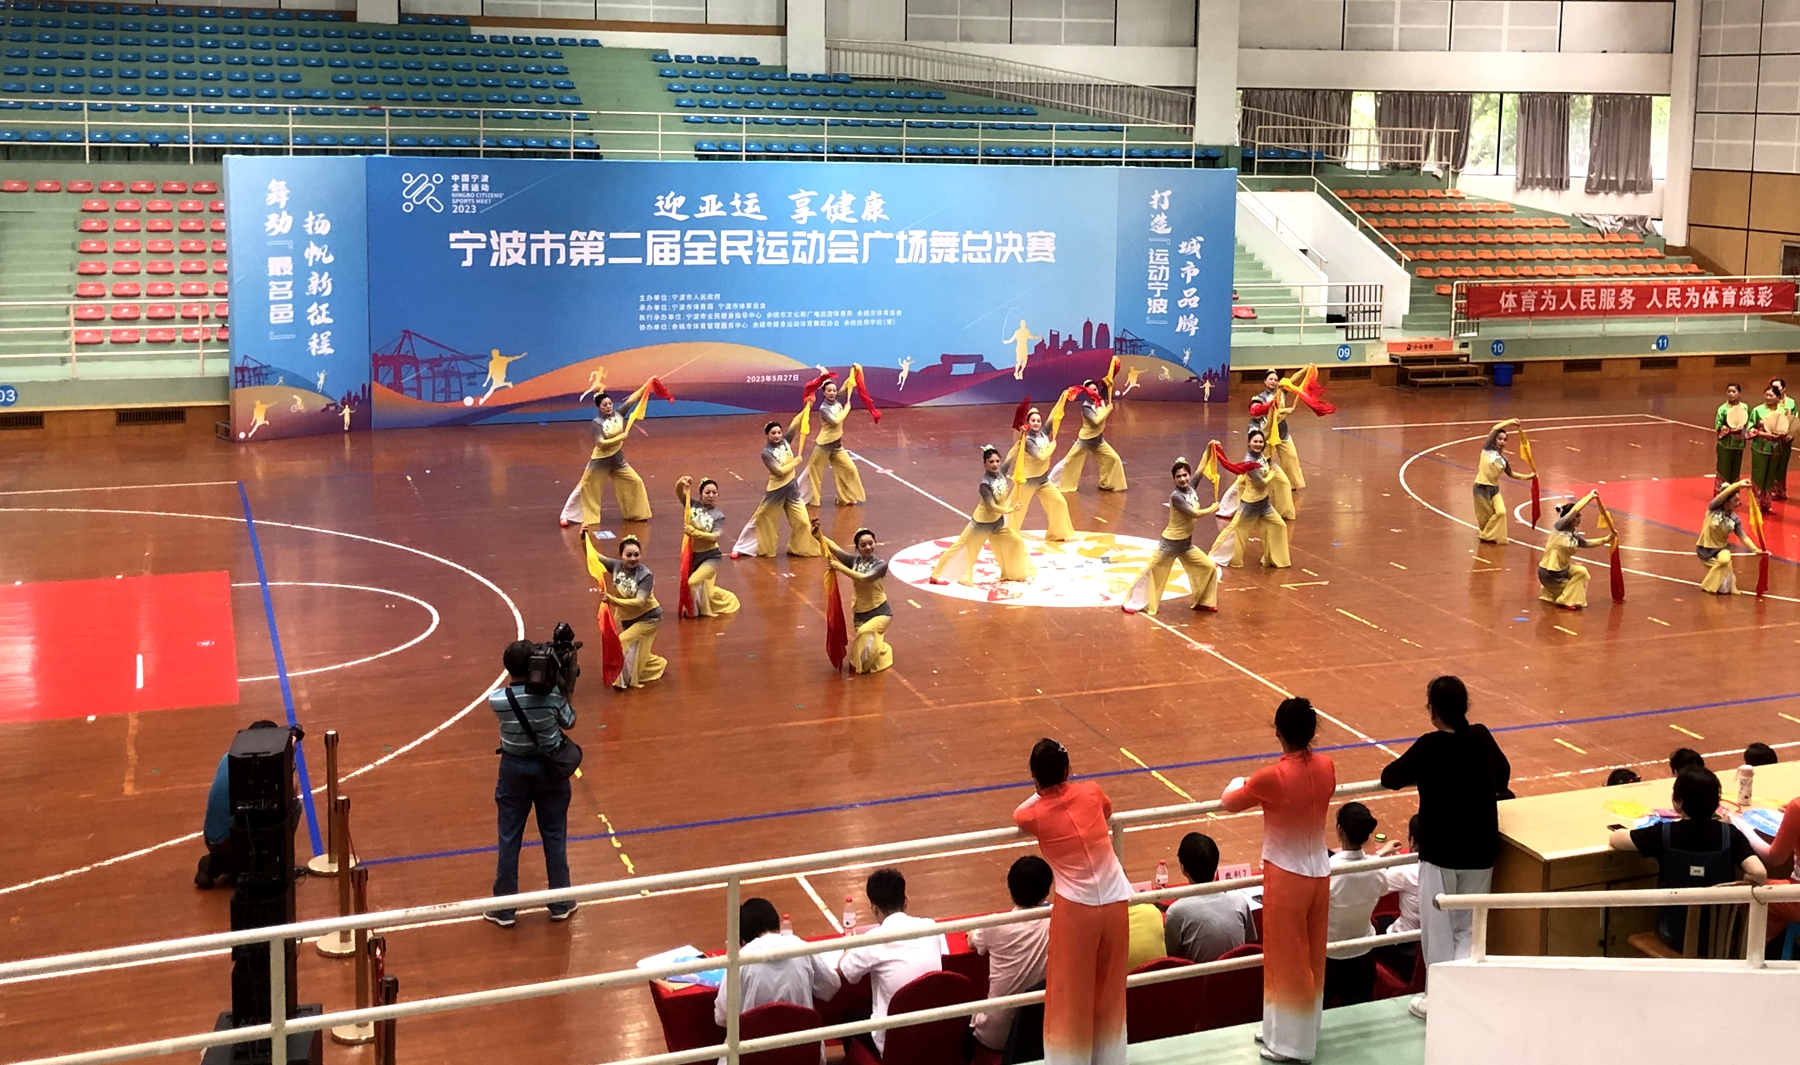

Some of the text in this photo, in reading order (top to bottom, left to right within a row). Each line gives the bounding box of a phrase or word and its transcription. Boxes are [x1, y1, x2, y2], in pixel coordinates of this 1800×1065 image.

[451, 174, 490, 183] 中国宁波
[451, 183, 490, 192] 全民运动
[452, 204, 477, 214] 2023
[653, 188, 890, 225] 迎亚运 享健康
[449, 229, 1056, 267] 宁波市第二届全民运动会广场舞总决赛
[303, 210, 335, 356] 扬帆新征程
[1175, 236, 1205, 337] 城市品牌
[1500, 285, 1774, 313] 体育为人民服务 人民为体育添彩
[1492, 343, 1504, 353] 10
[1658, 339, 1668, 349] 11
[1338, 348, 1350, 358] 09
[746, 374, 799, 383] 2023年5月27日
